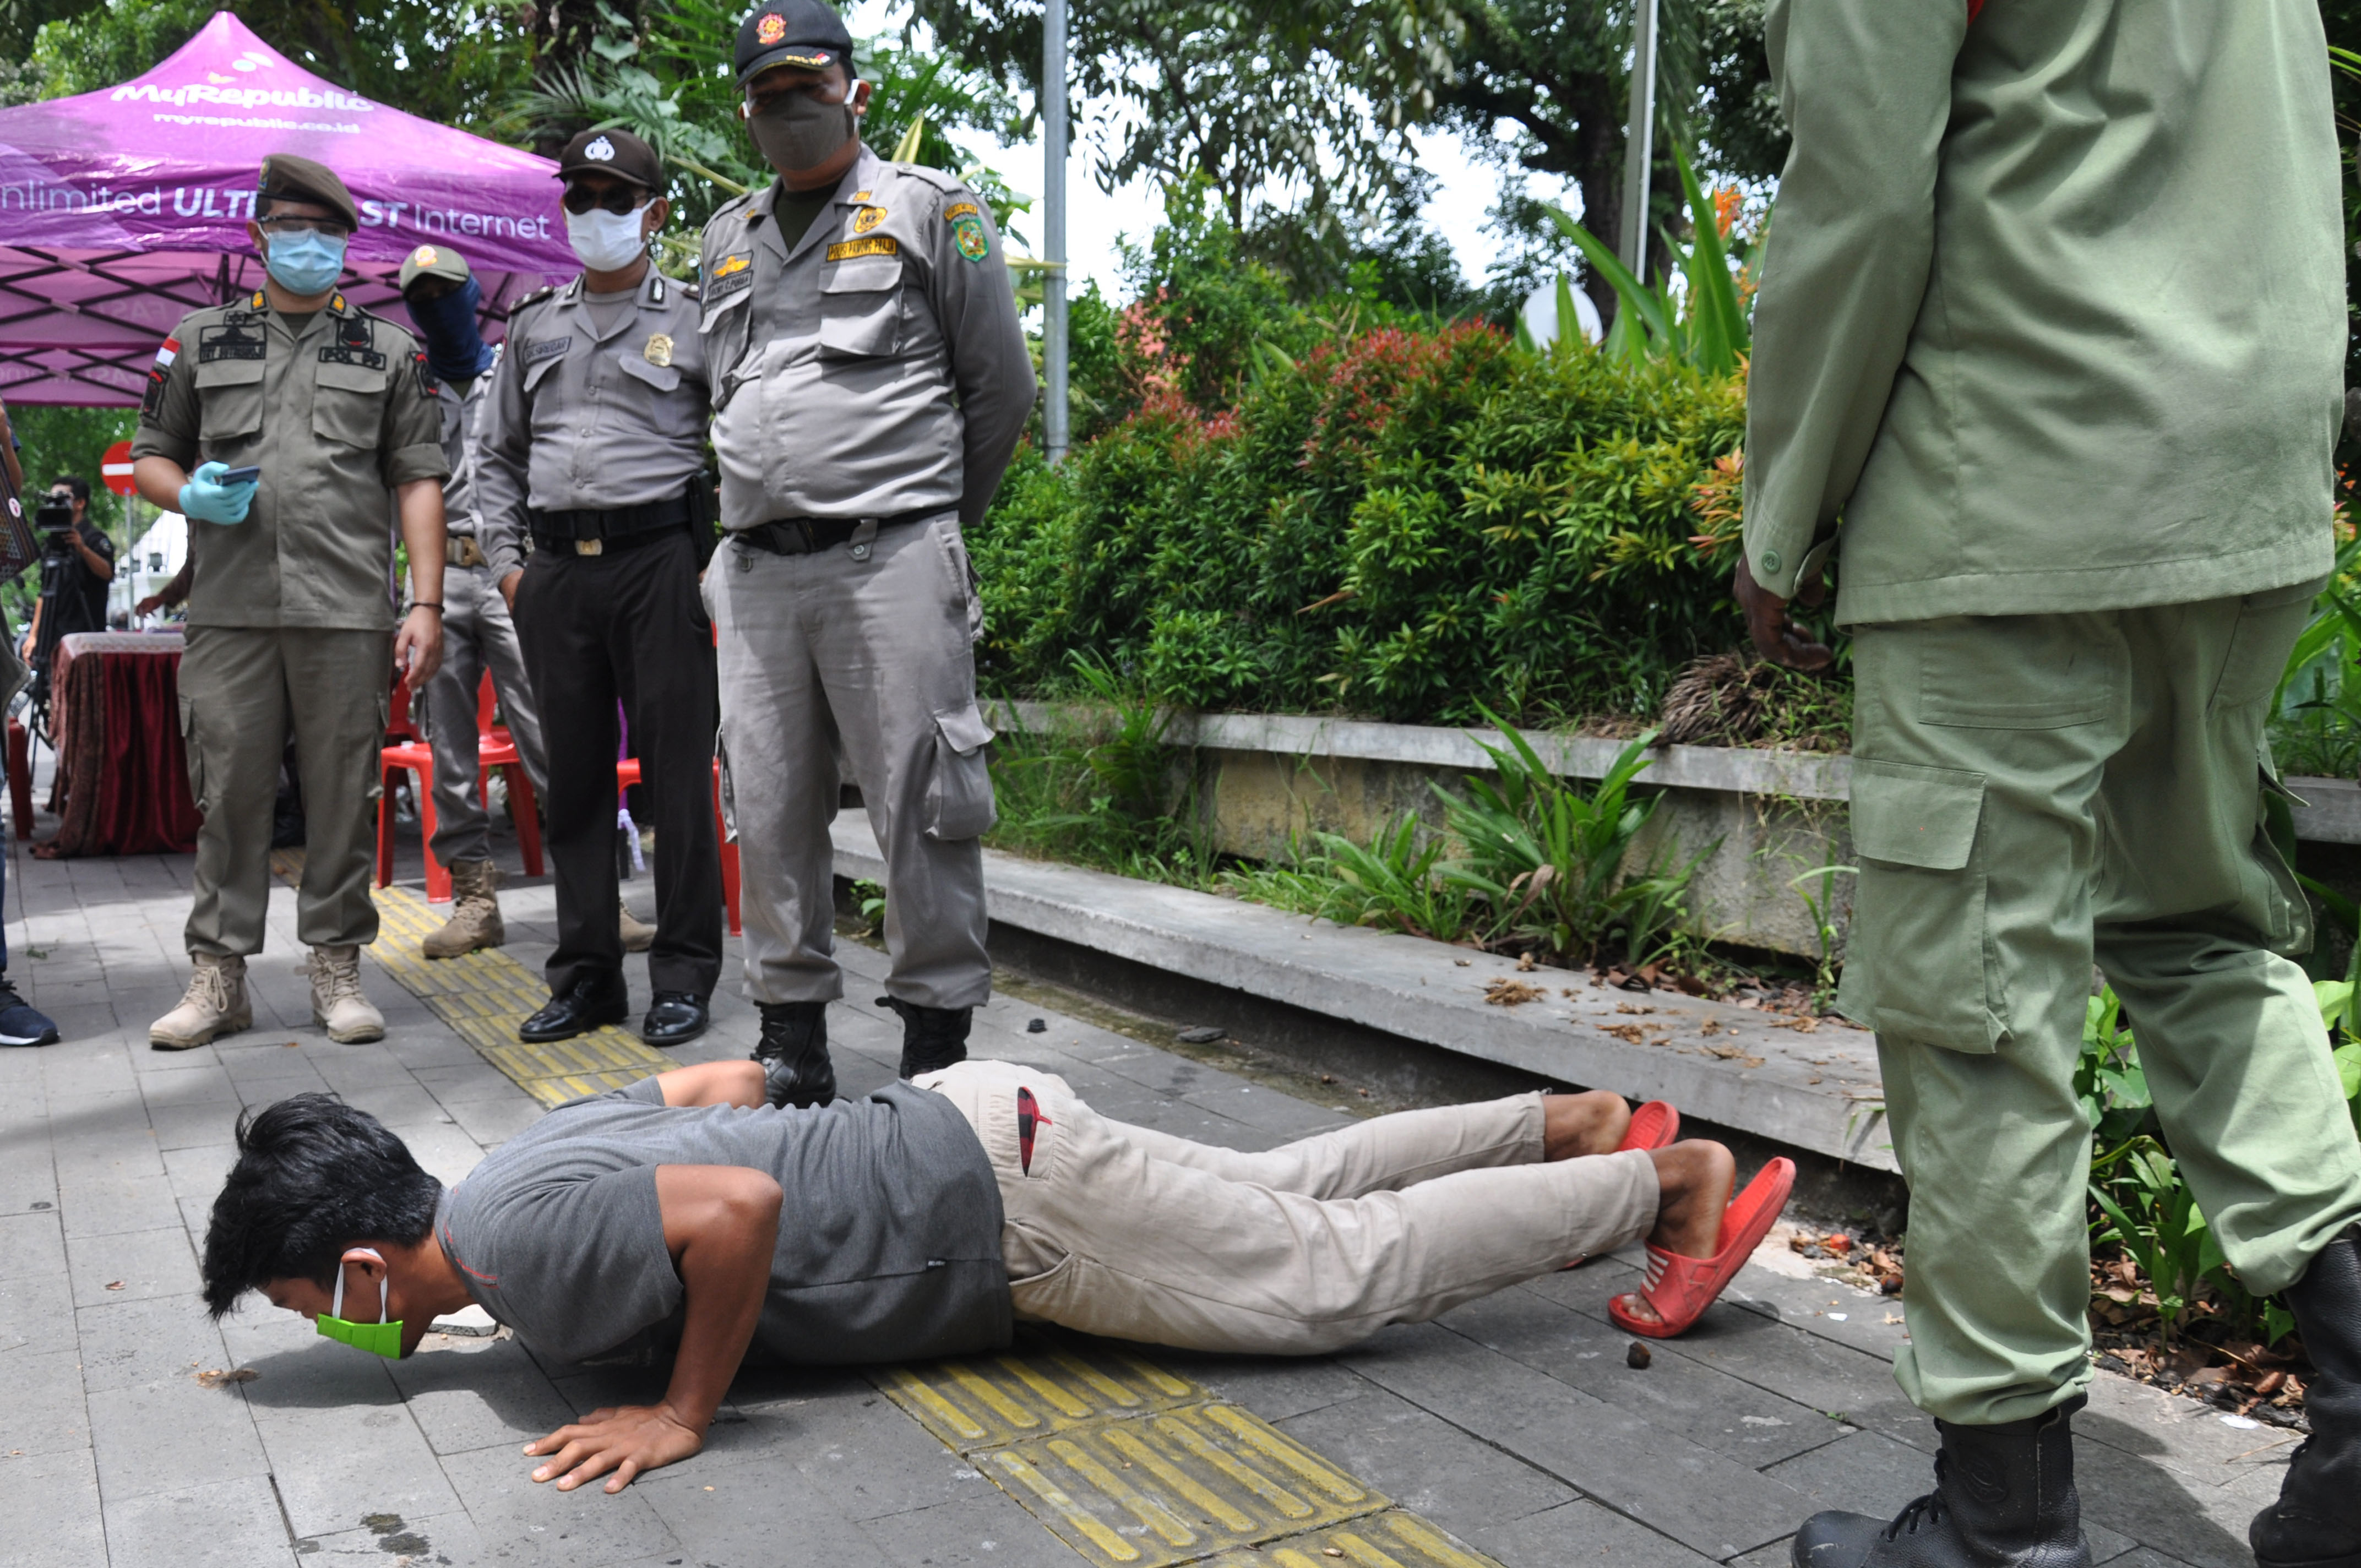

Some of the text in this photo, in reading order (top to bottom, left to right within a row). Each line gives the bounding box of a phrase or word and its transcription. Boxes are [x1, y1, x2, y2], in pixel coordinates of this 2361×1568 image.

[111, 84, 374, 112] MyRepublic
[153, 113, 361, 134] myrepublic.co.id
[1, 179, 161, 215] nlimited
[415, 203, 551, 241] Internet
[323, 349, 382, 368] POL PP
